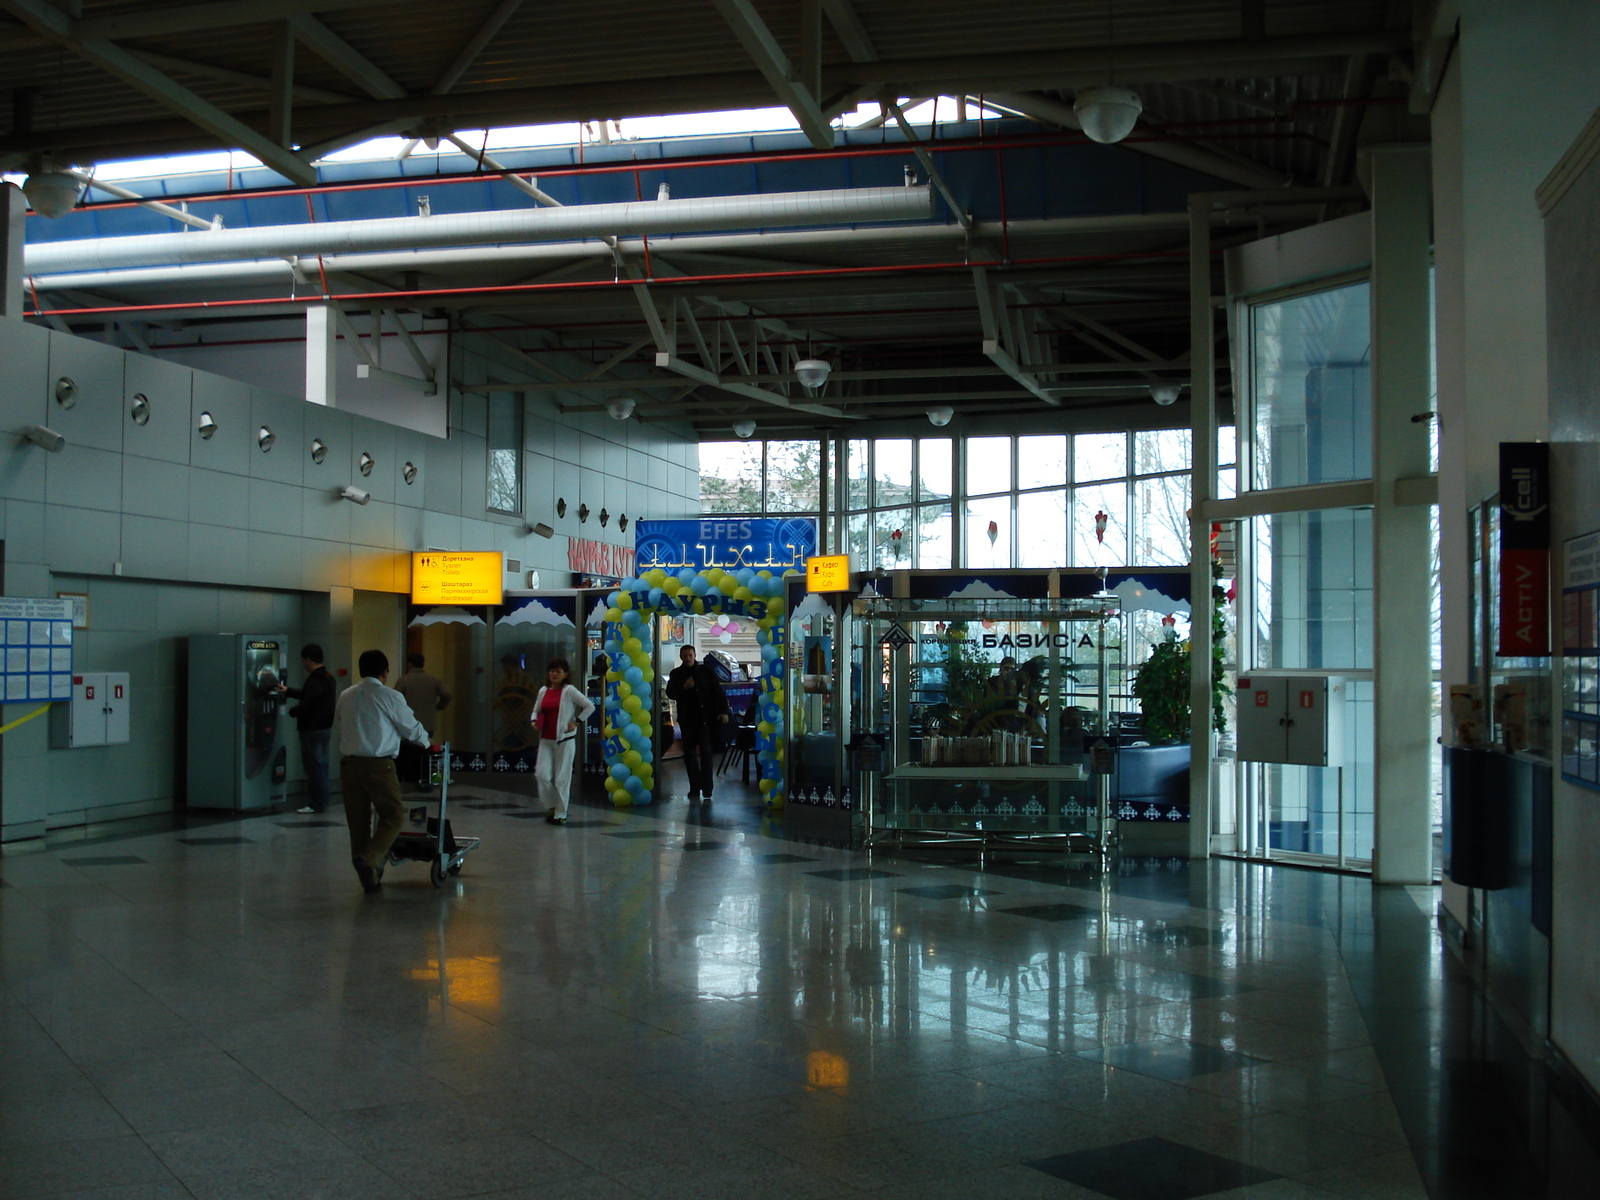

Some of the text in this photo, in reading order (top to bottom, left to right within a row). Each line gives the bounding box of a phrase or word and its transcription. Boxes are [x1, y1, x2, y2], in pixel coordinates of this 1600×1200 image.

[700, 522, 752, 540] EFES
[567, 537, 611, 576] НАУРЫЗ
[629, 590, 767, 619] НАУРЫЗ
[1516, 564, 1533, 643] ACTIV
